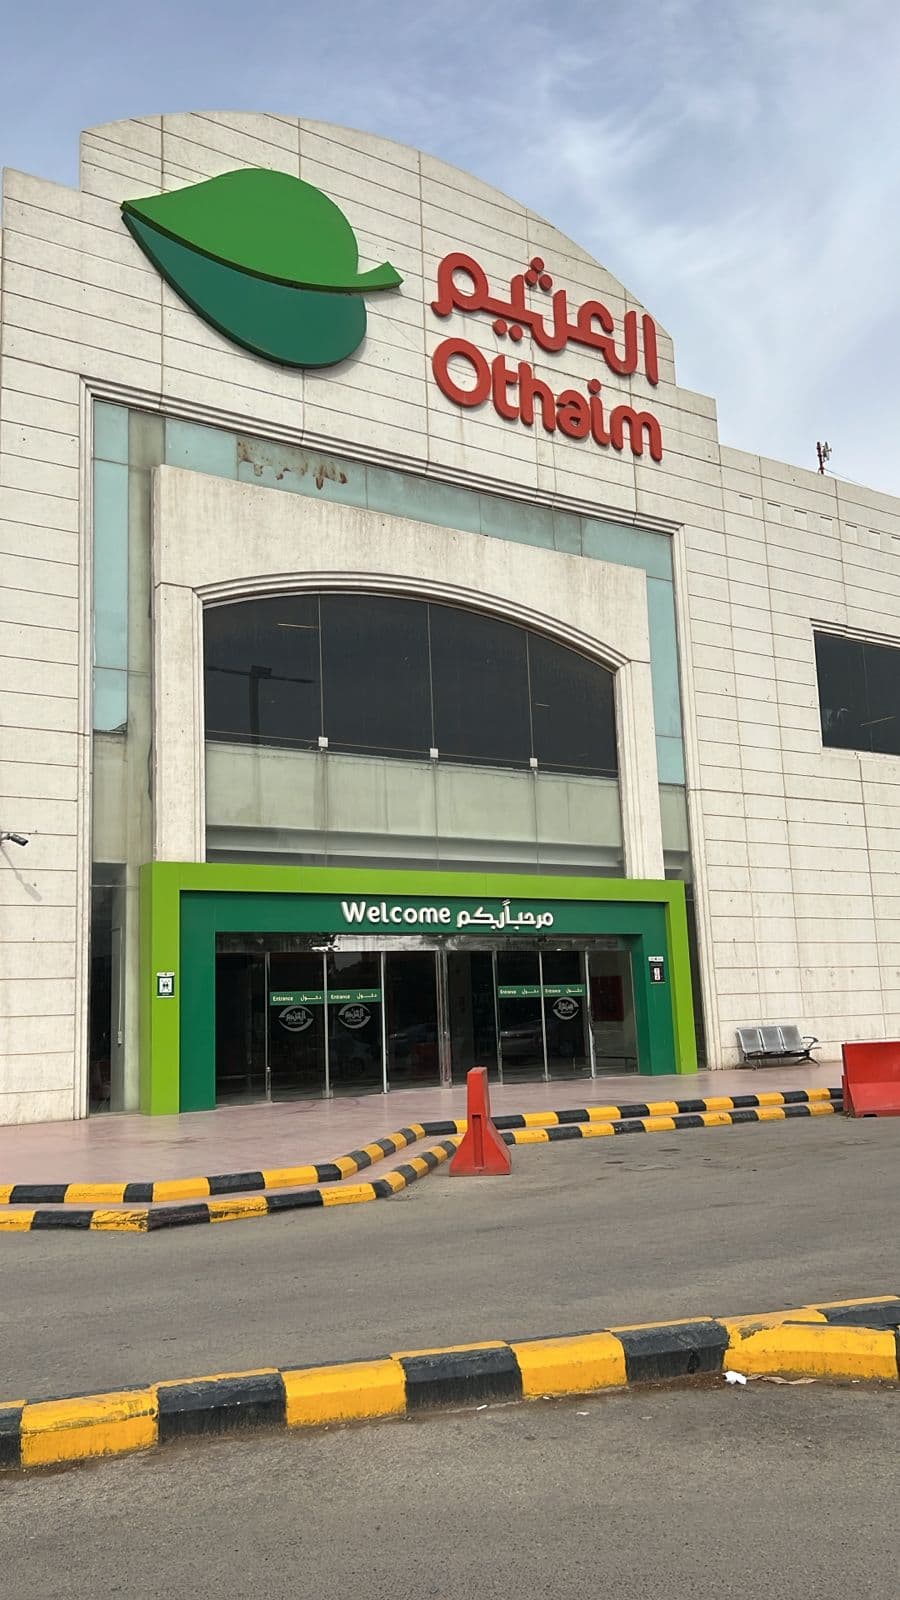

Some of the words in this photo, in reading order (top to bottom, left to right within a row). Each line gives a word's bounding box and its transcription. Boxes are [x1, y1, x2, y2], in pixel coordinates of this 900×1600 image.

[431, 252, 659, 385] العثيم
[432, 337, 663, 462] Othaim
[341, 901, 451, 924] Welcome
